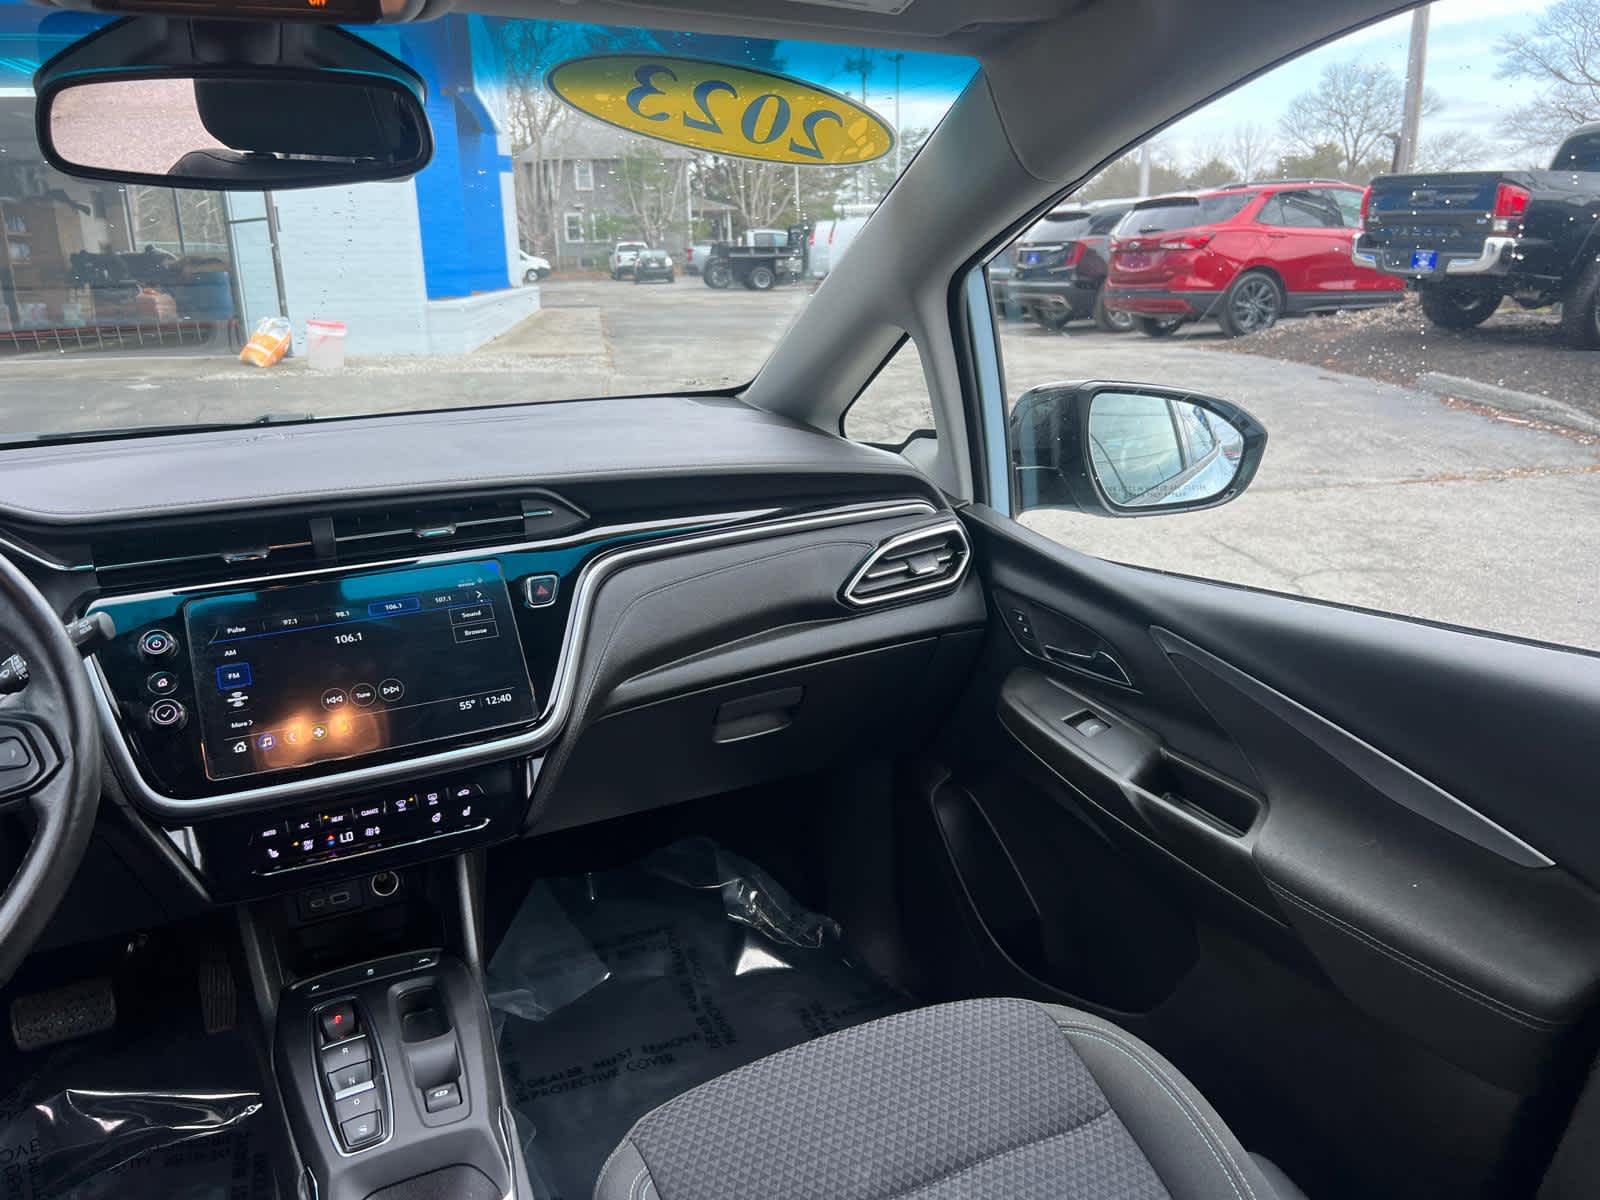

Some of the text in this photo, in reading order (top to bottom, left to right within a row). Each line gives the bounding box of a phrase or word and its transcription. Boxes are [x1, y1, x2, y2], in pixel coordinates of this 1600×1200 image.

[461, 610, 482, 618] Sound
[227, 626, 246, 634] Pulse
[464, 627, 488, 636] Browse
[334, 632, 363, 645] 106.1
[228, 672, 240, 680] FM
[356, 691, 371, 699] Tune
[485, 693, 512, 706] 12:40
[361, 808, 379, 816] CLIMATE
[339, 831, 354, 843] LO
[626, 1053, 676, 1072] COVER
